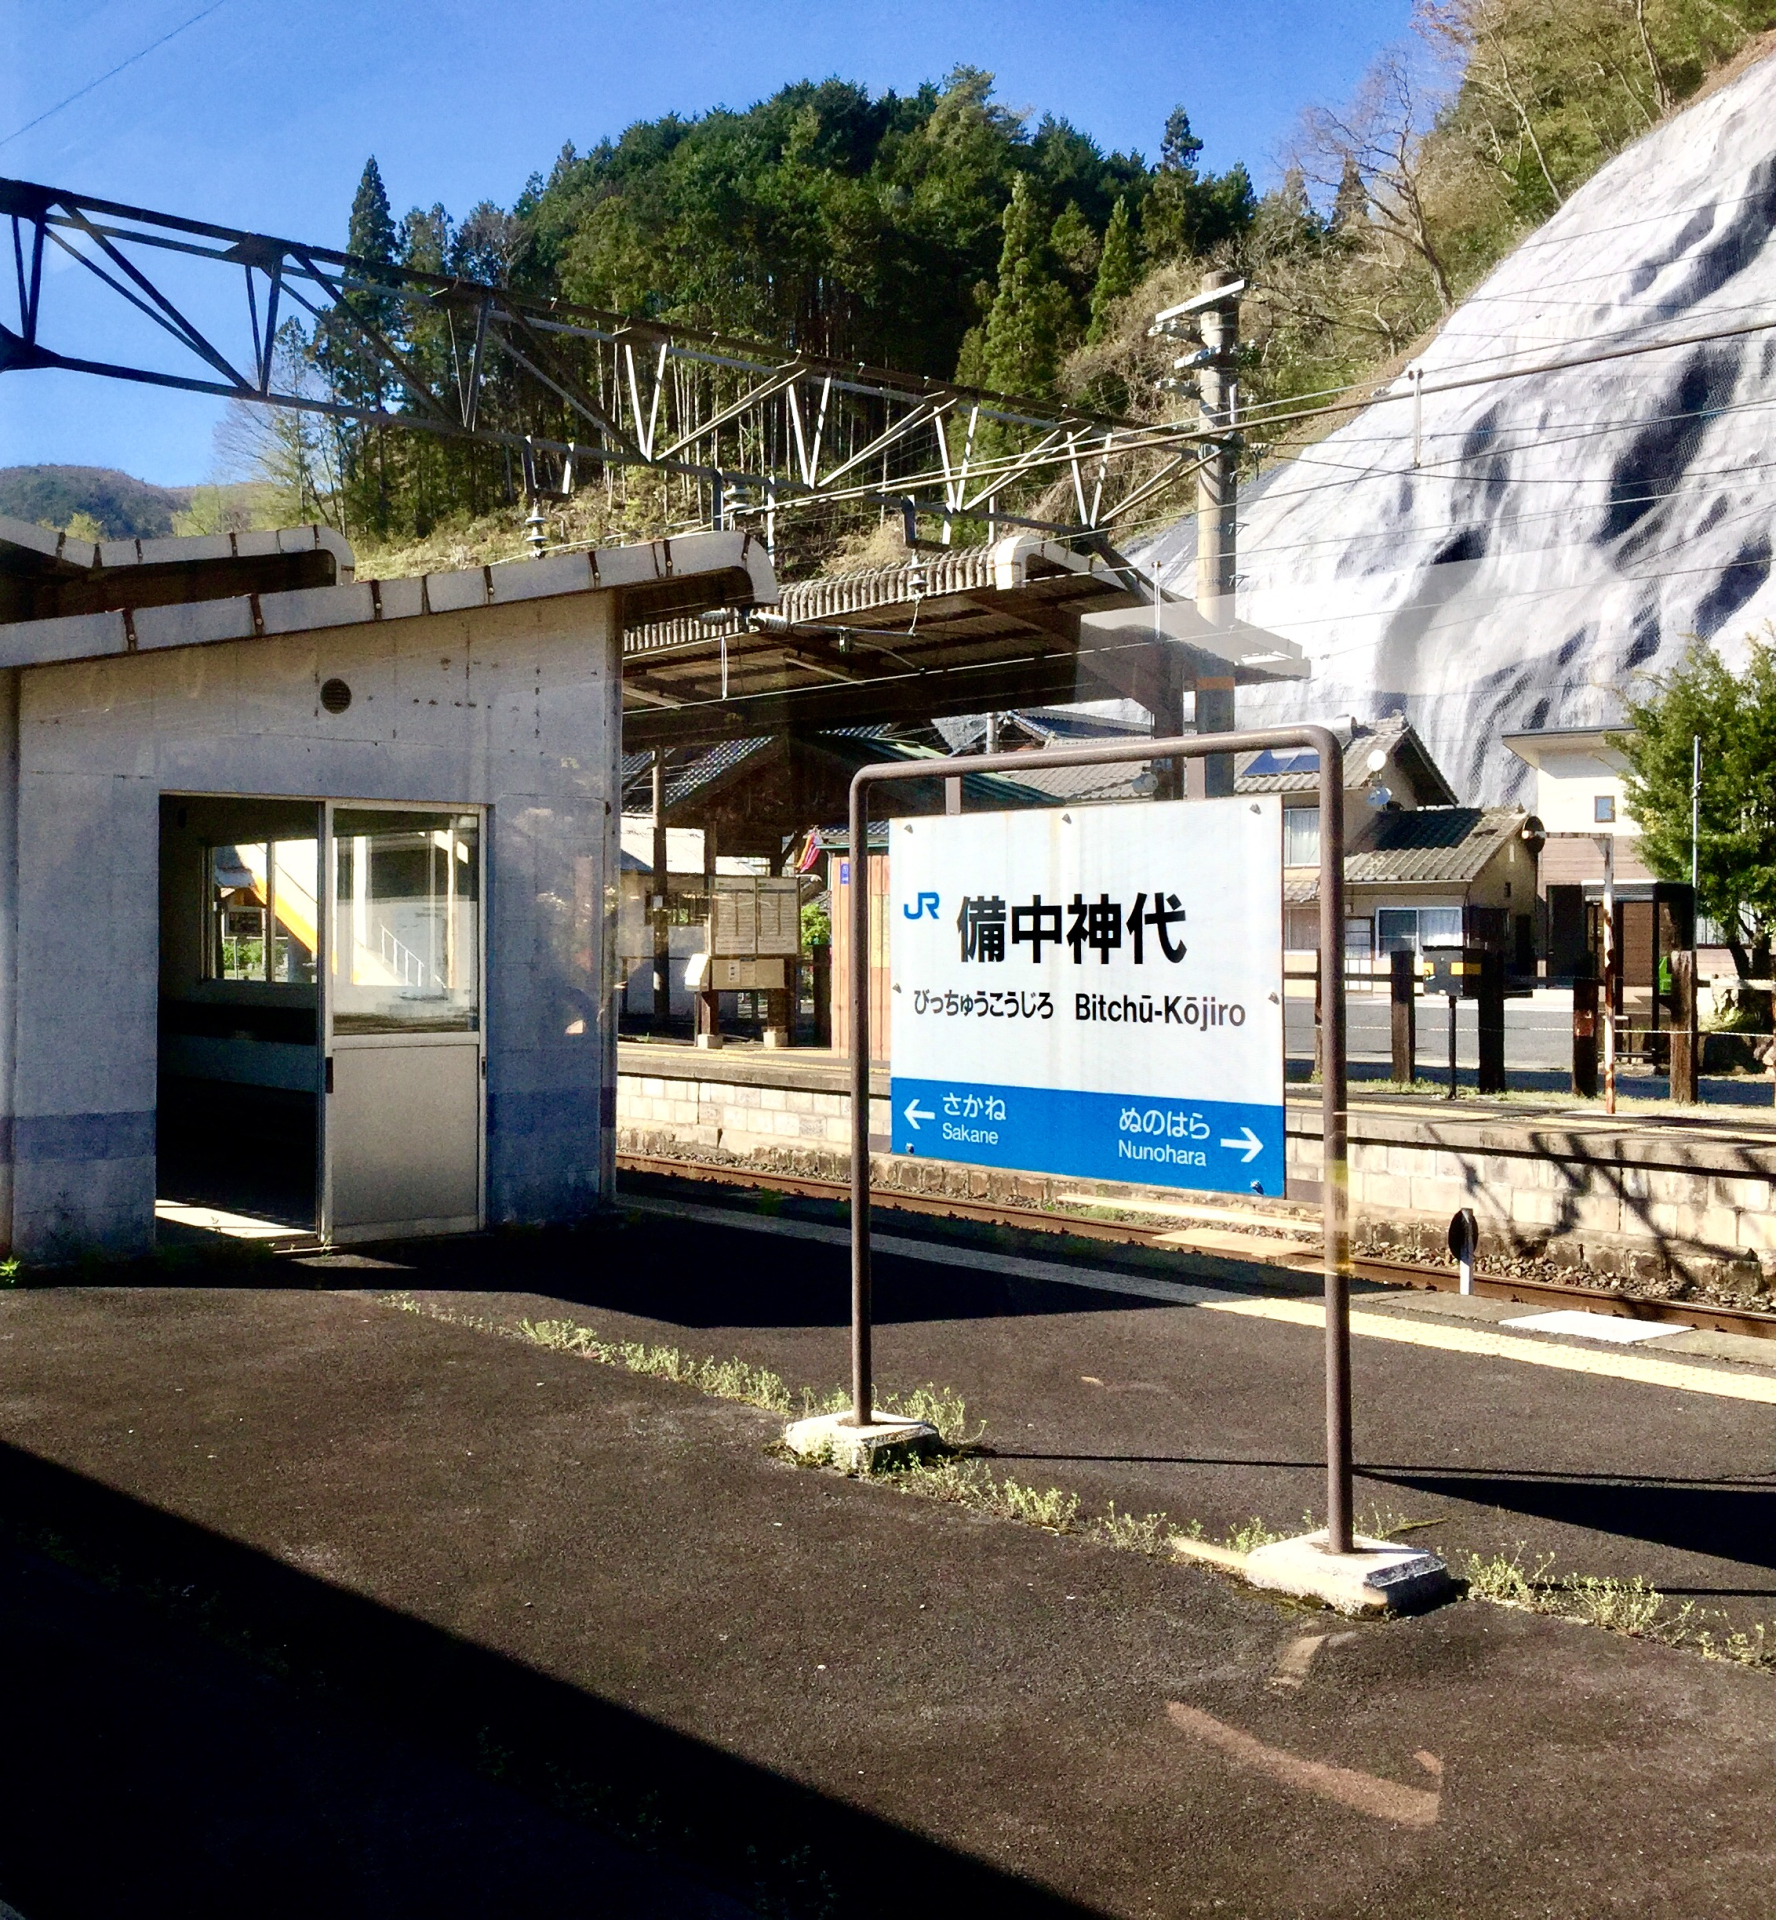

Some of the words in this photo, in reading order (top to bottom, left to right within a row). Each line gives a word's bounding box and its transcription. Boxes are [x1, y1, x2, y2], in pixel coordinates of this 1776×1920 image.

[903, 892, 940, 920] JR
[957, 892, 1187, 965] 備中神代
[914, 989, 1054, 1020] びっちゅうこうじろ
[1075, 992, 1246, 1031] Bitchū-Kōjiro
[942, 1092, 1006, 1121] さかね
[942, 1122, 999, 1145] Sakane
[1119, 1107, 1211, 1140] ぬのはら
[1119, 1141, 1207, 1167] Nunohara
